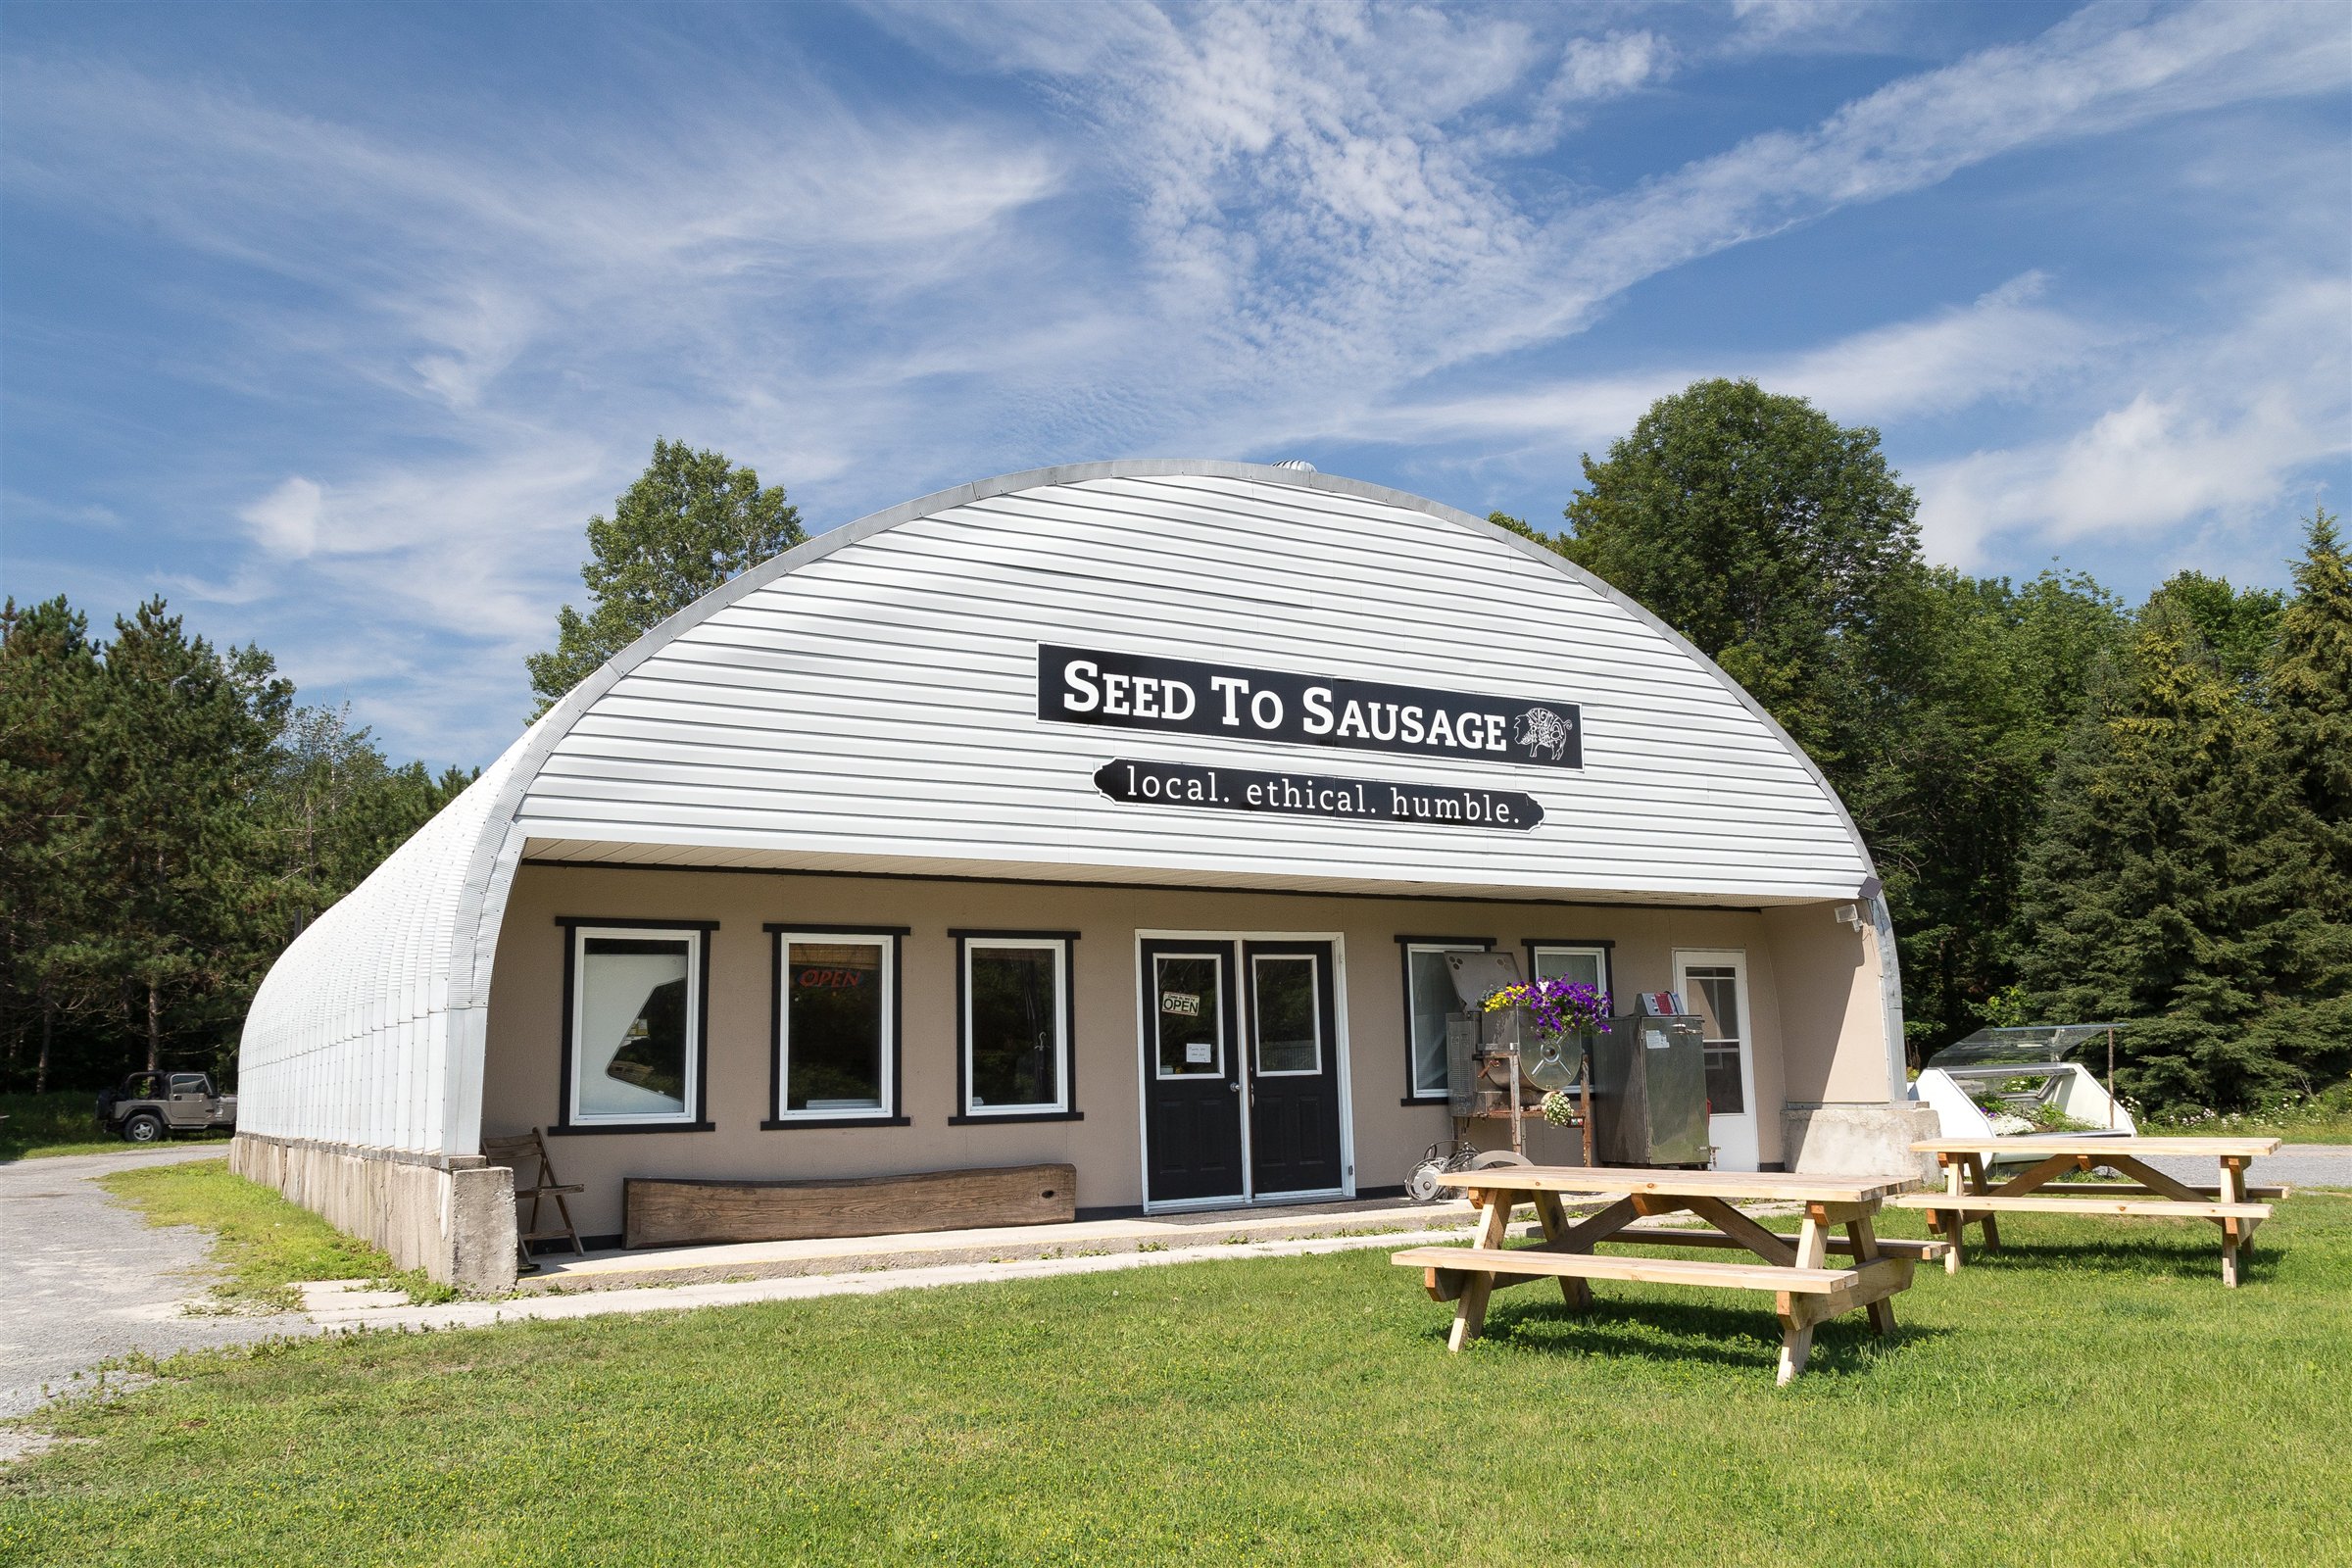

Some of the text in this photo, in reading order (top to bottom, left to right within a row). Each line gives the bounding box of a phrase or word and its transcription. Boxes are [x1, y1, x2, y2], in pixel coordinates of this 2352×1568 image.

[1063, 660, 1197, 721] SEED
[1210, 675, 1284, 730] TO
[1302, 686, 1507, 752] SAUSAGE
[1126, 764, 1520, 824] local. ethical. humble.
[799, 969, 861, 988] OPEN
[1163, 999, 1199, 1013] OPEN
